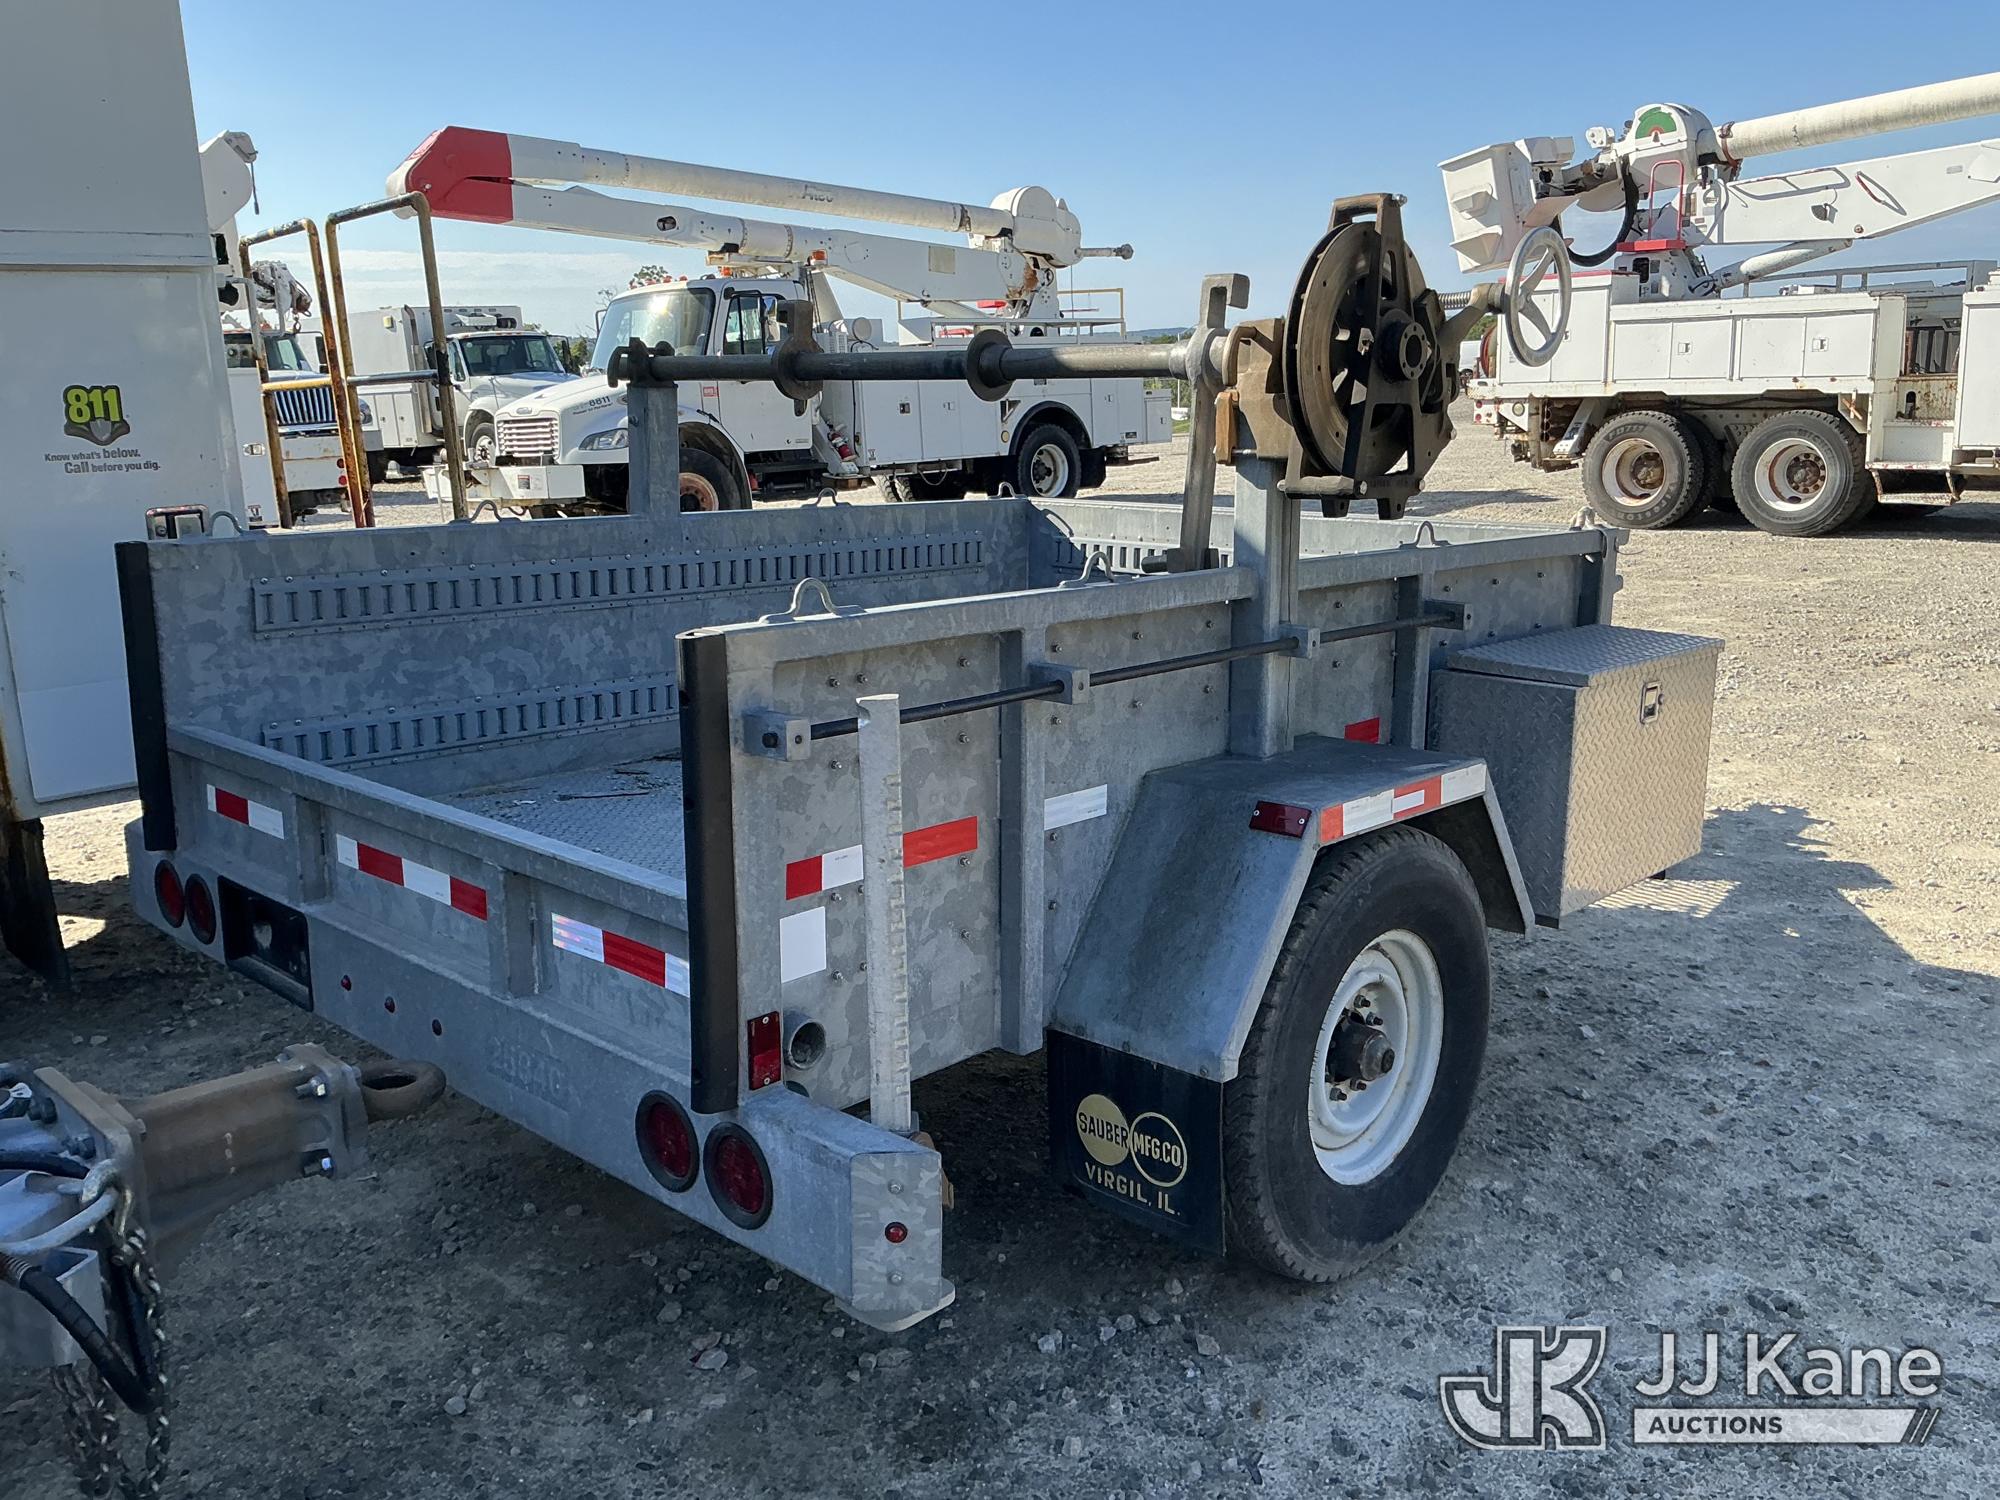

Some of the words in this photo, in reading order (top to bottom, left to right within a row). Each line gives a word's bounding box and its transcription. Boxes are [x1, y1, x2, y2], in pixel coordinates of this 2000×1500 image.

[66, 387, 121, 424] 811
[44, 453, 70, 462] Know
[72, 451, 101, 461] what's
[102, 448, 141, 459] below.
[64, 461, 90, 474] Call
[91, 462, 123, 473] before
[125, 462, 142, 472] you
[143, 460, 161, 471] dig.
[1078, 1112, 1129, 1149] SAUBER
[1084, 1161, 1152, 1207] VIRGIL,
[1157, 1191, 1181, 1216] IL.
